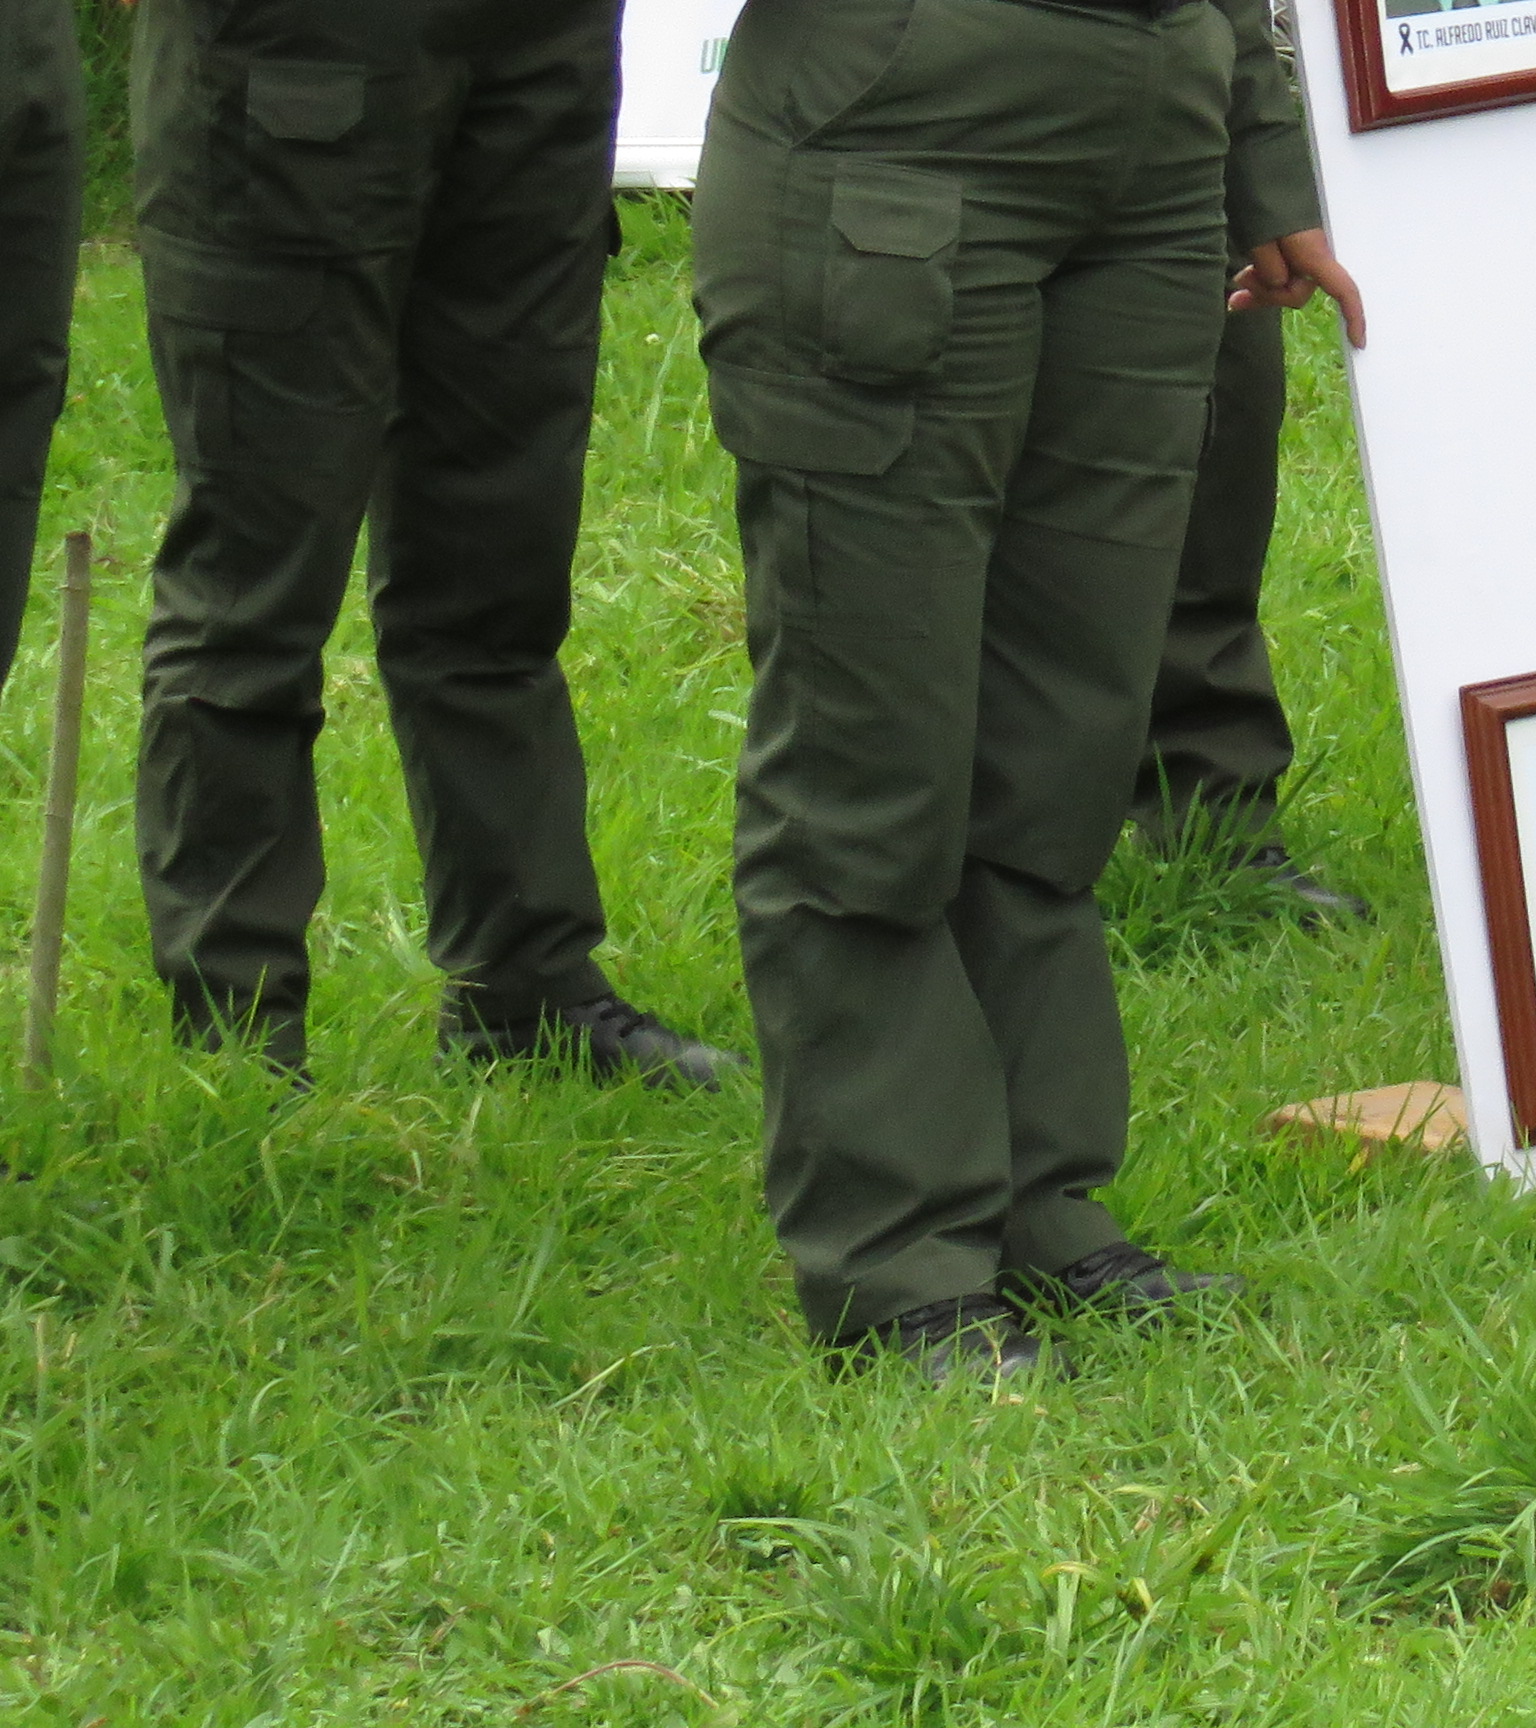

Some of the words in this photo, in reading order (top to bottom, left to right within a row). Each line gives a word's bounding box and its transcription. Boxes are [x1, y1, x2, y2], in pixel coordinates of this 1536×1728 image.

[1416, 29, 1434, 50] TC.
[1435, 22, 1483, 47] ALFREDO
[1485, 19, 1509, 41] RUIZ
